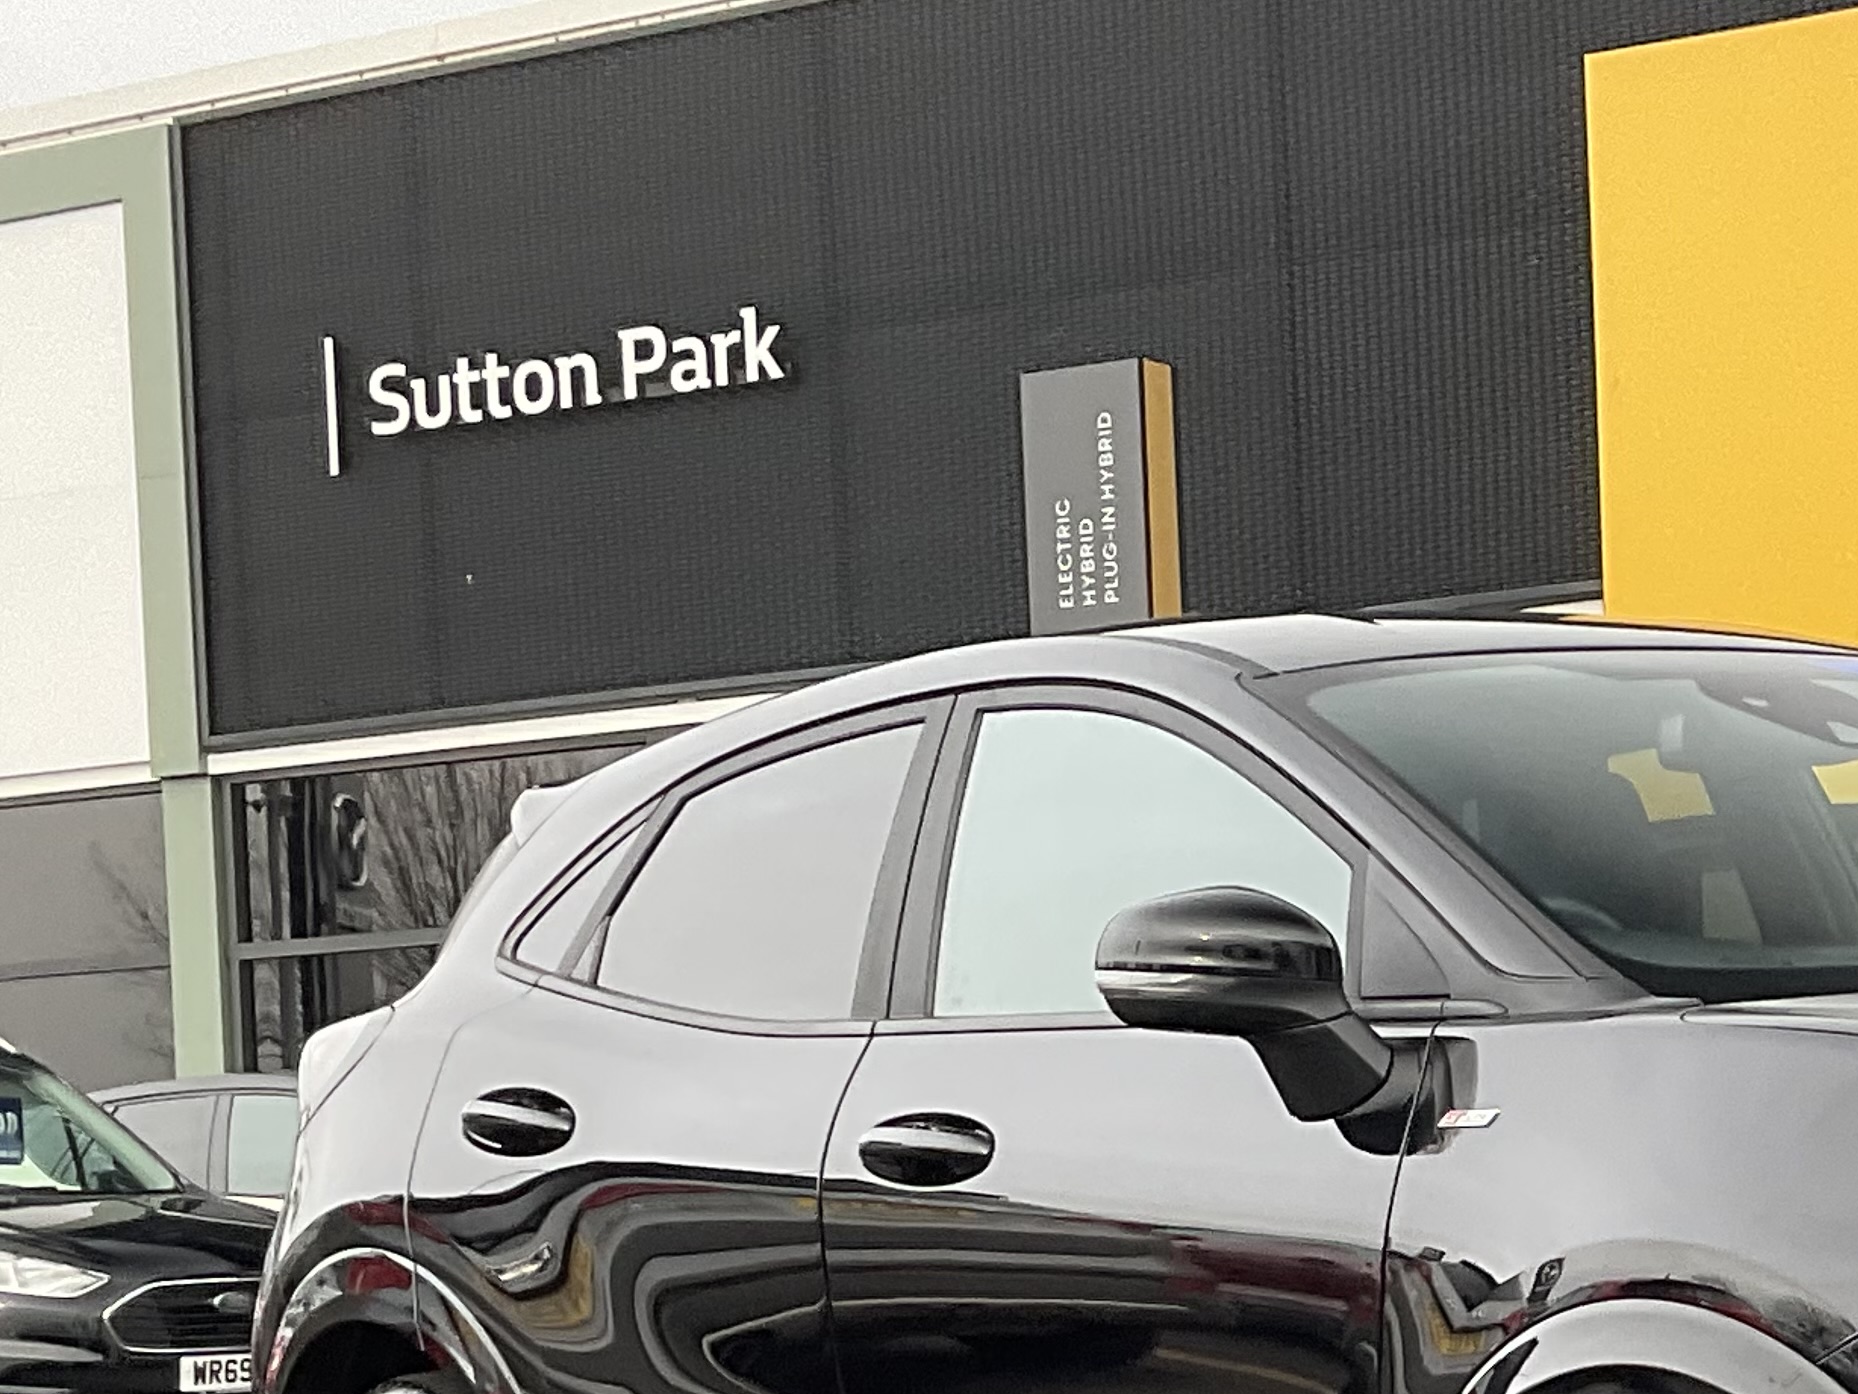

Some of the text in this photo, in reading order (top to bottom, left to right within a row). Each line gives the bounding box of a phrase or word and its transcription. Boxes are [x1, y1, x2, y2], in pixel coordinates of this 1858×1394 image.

[368, 307, 785, 437] Sutton Park
[1055, 497, 1075, 609] ELECTRIC
[1078, 517, 1097, 606] HYBRID
[1096, 411, 1120, 604] PLUG-IN HYBRID
